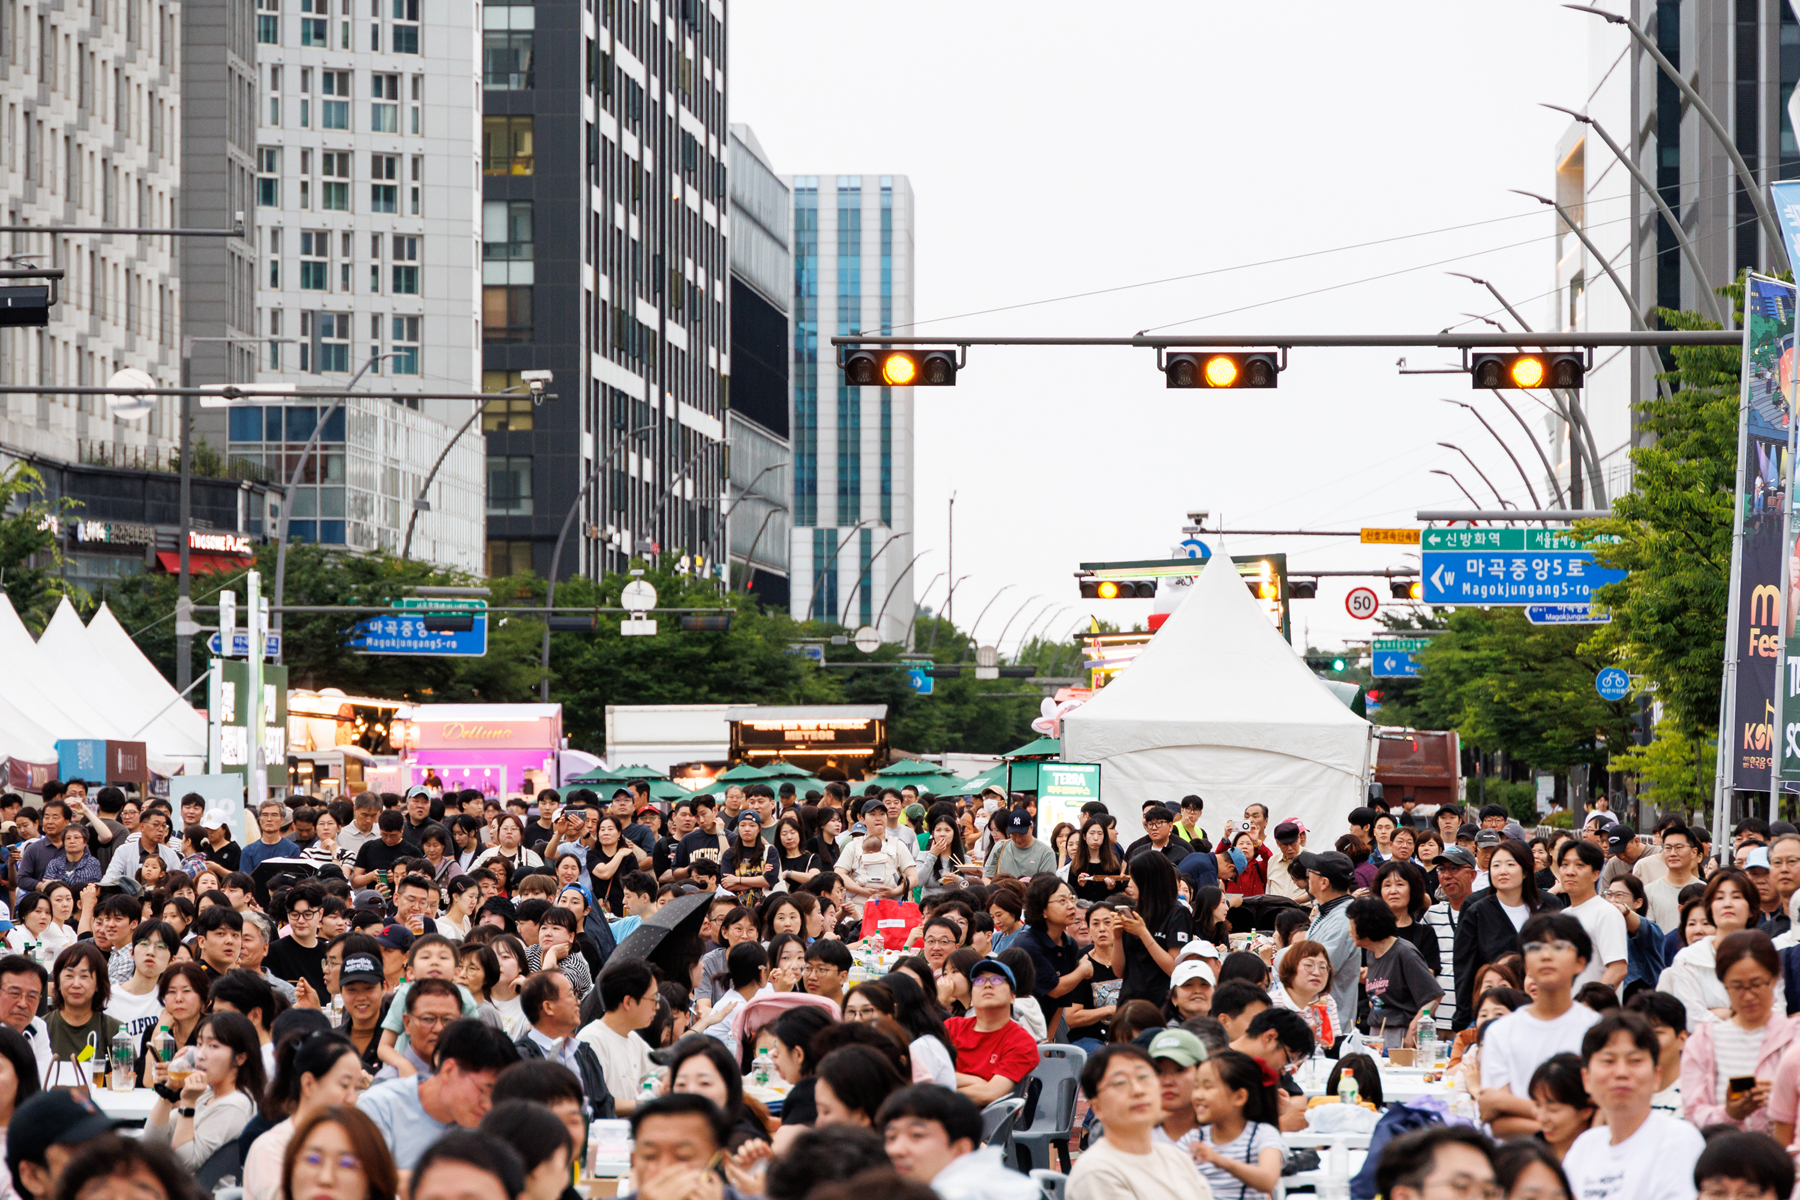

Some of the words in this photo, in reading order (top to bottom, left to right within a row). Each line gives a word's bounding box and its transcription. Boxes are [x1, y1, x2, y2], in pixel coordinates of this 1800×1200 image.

[1445, 531, 1501, 547] 신방화역
[1466, 558, 1585, 581] 마곡중앙5로
[1462, 582, 1590, 599] Magokjungang5-ro
[1353, 596, 1371, 610] 50
[784, 730, 836, 741] METEOR
[1052, 772, 1086, 787] TERRA
